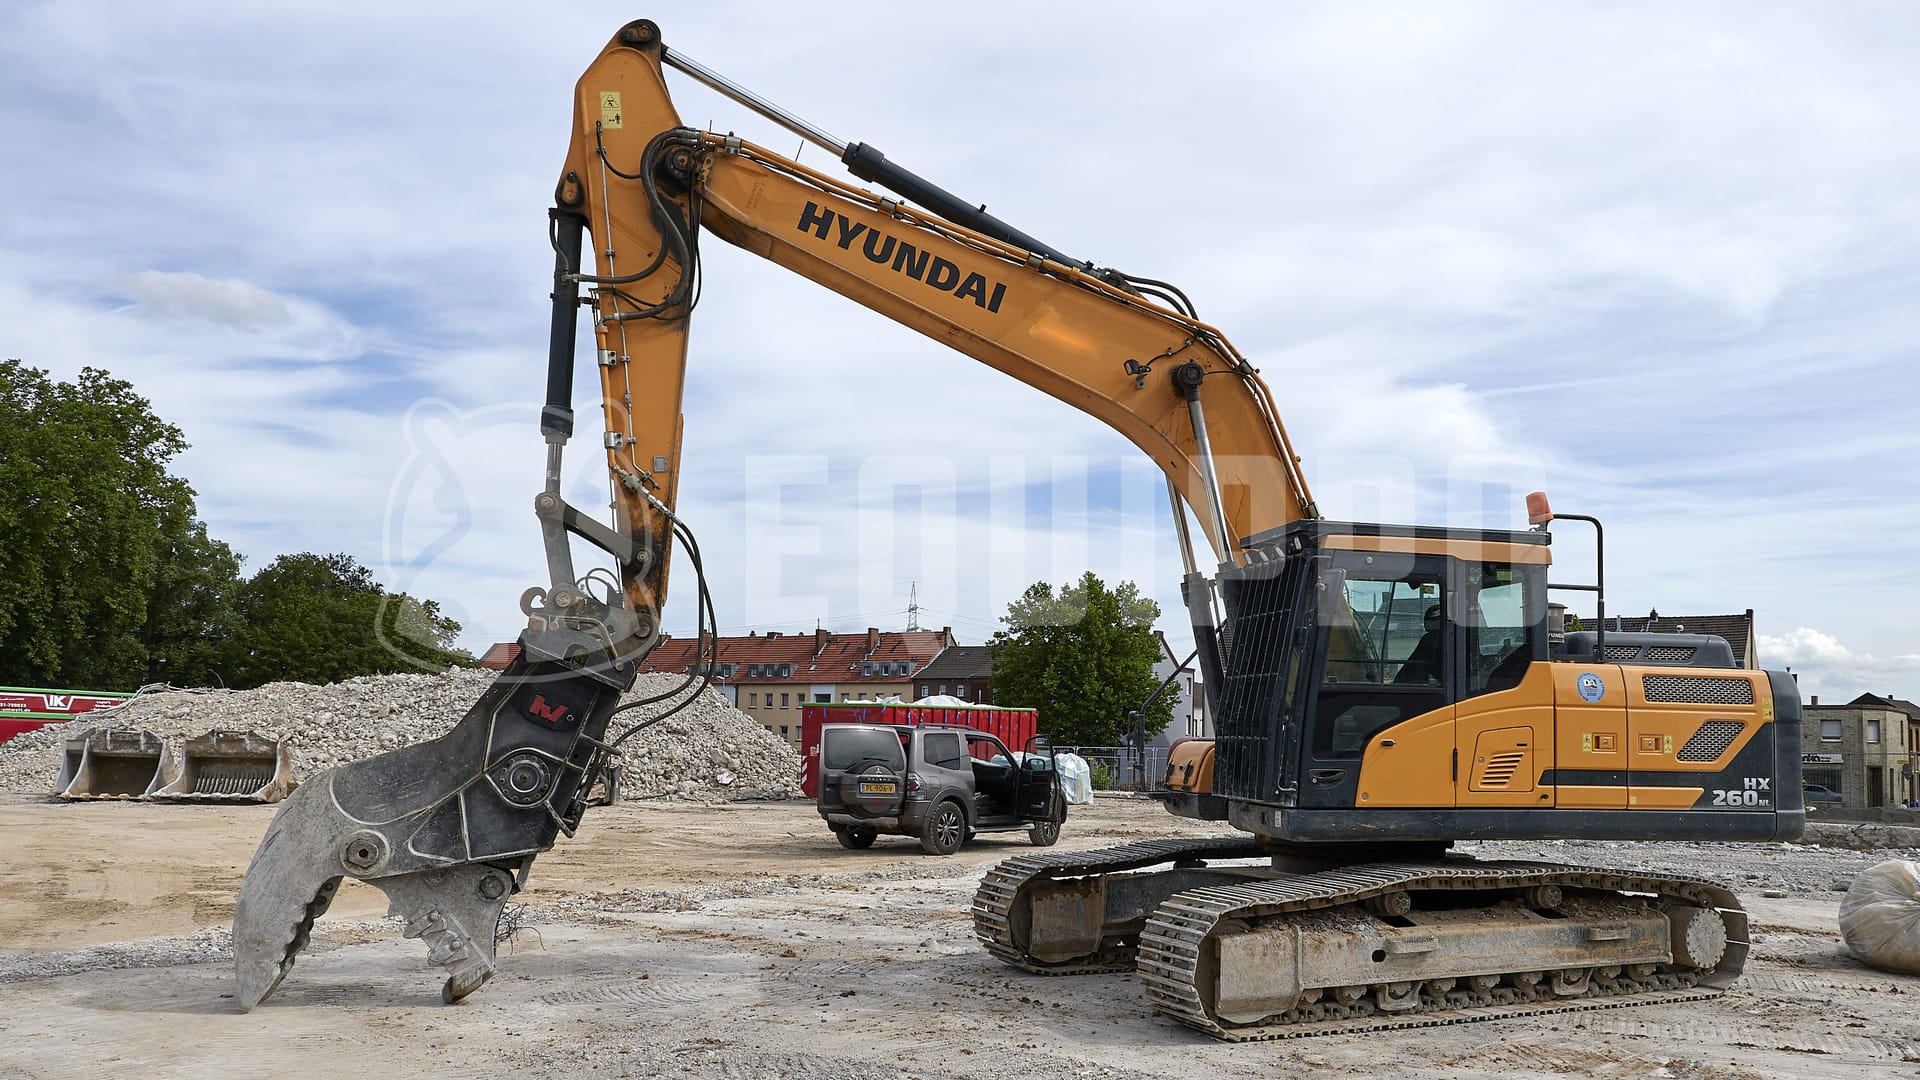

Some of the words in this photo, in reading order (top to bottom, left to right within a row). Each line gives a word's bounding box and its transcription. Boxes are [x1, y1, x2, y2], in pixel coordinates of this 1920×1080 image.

[797, 201, 1007, 313] HYUNDAI
[1743, 777, 1770, 790] HX
[1712, 789, 1758, 806] 260
